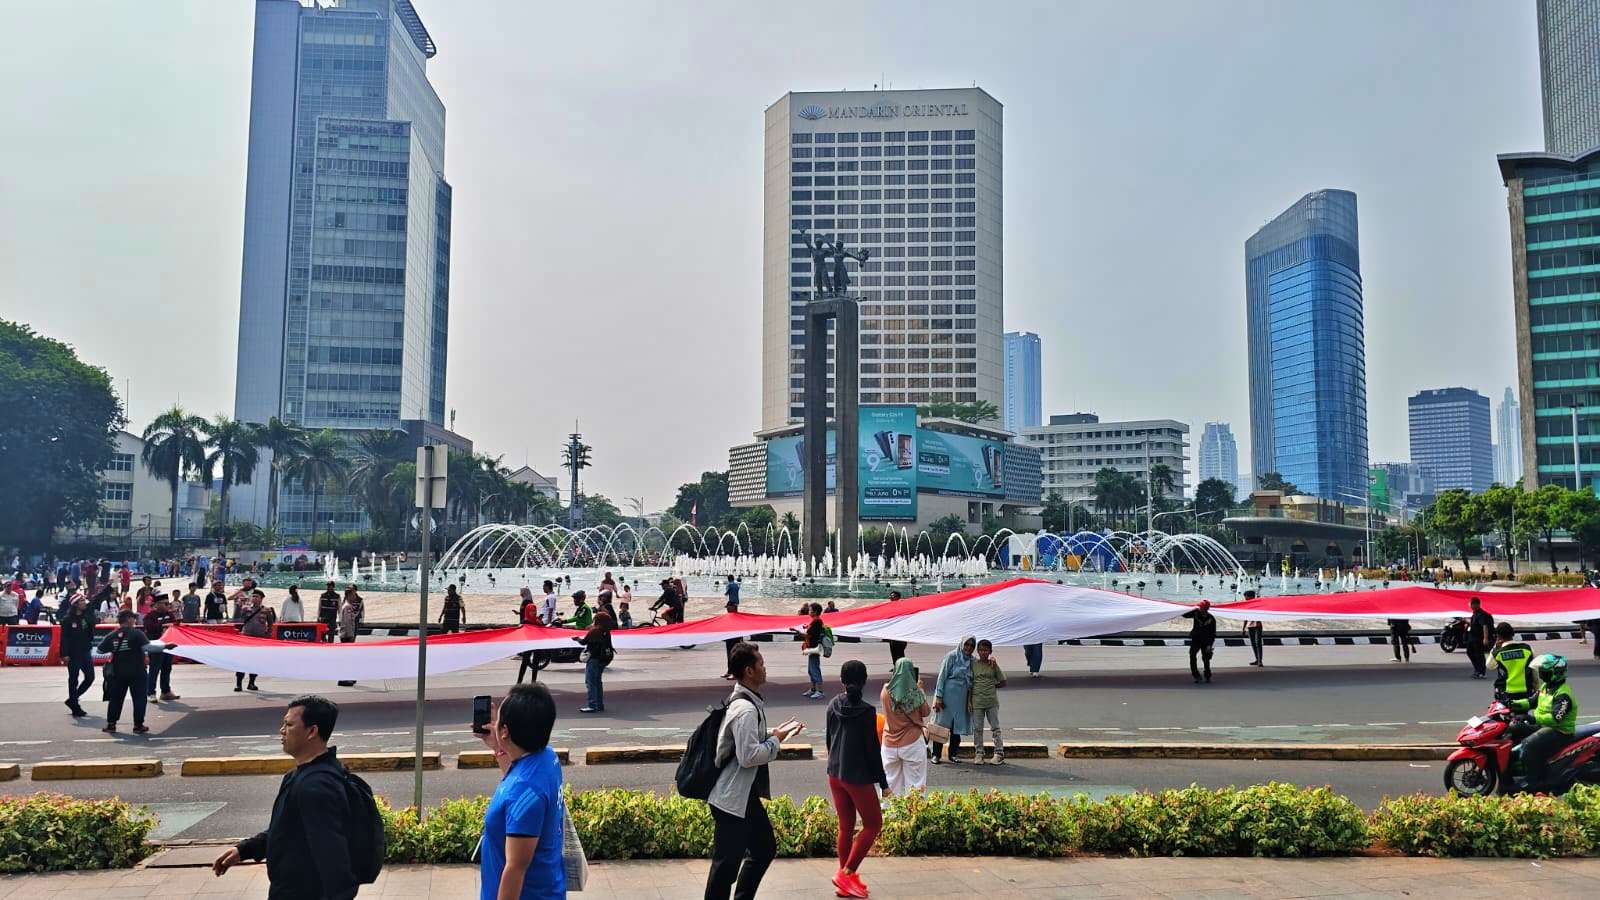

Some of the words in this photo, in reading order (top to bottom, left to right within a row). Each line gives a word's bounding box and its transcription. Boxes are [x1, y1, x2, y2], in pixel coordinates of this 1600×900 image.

[827, 105, 899, 119] MANDARIN
[903, 103, 969, 117] ORIENTAL
[25, 633, 44, 641] triv
[292, 630, 309, 638] triv
